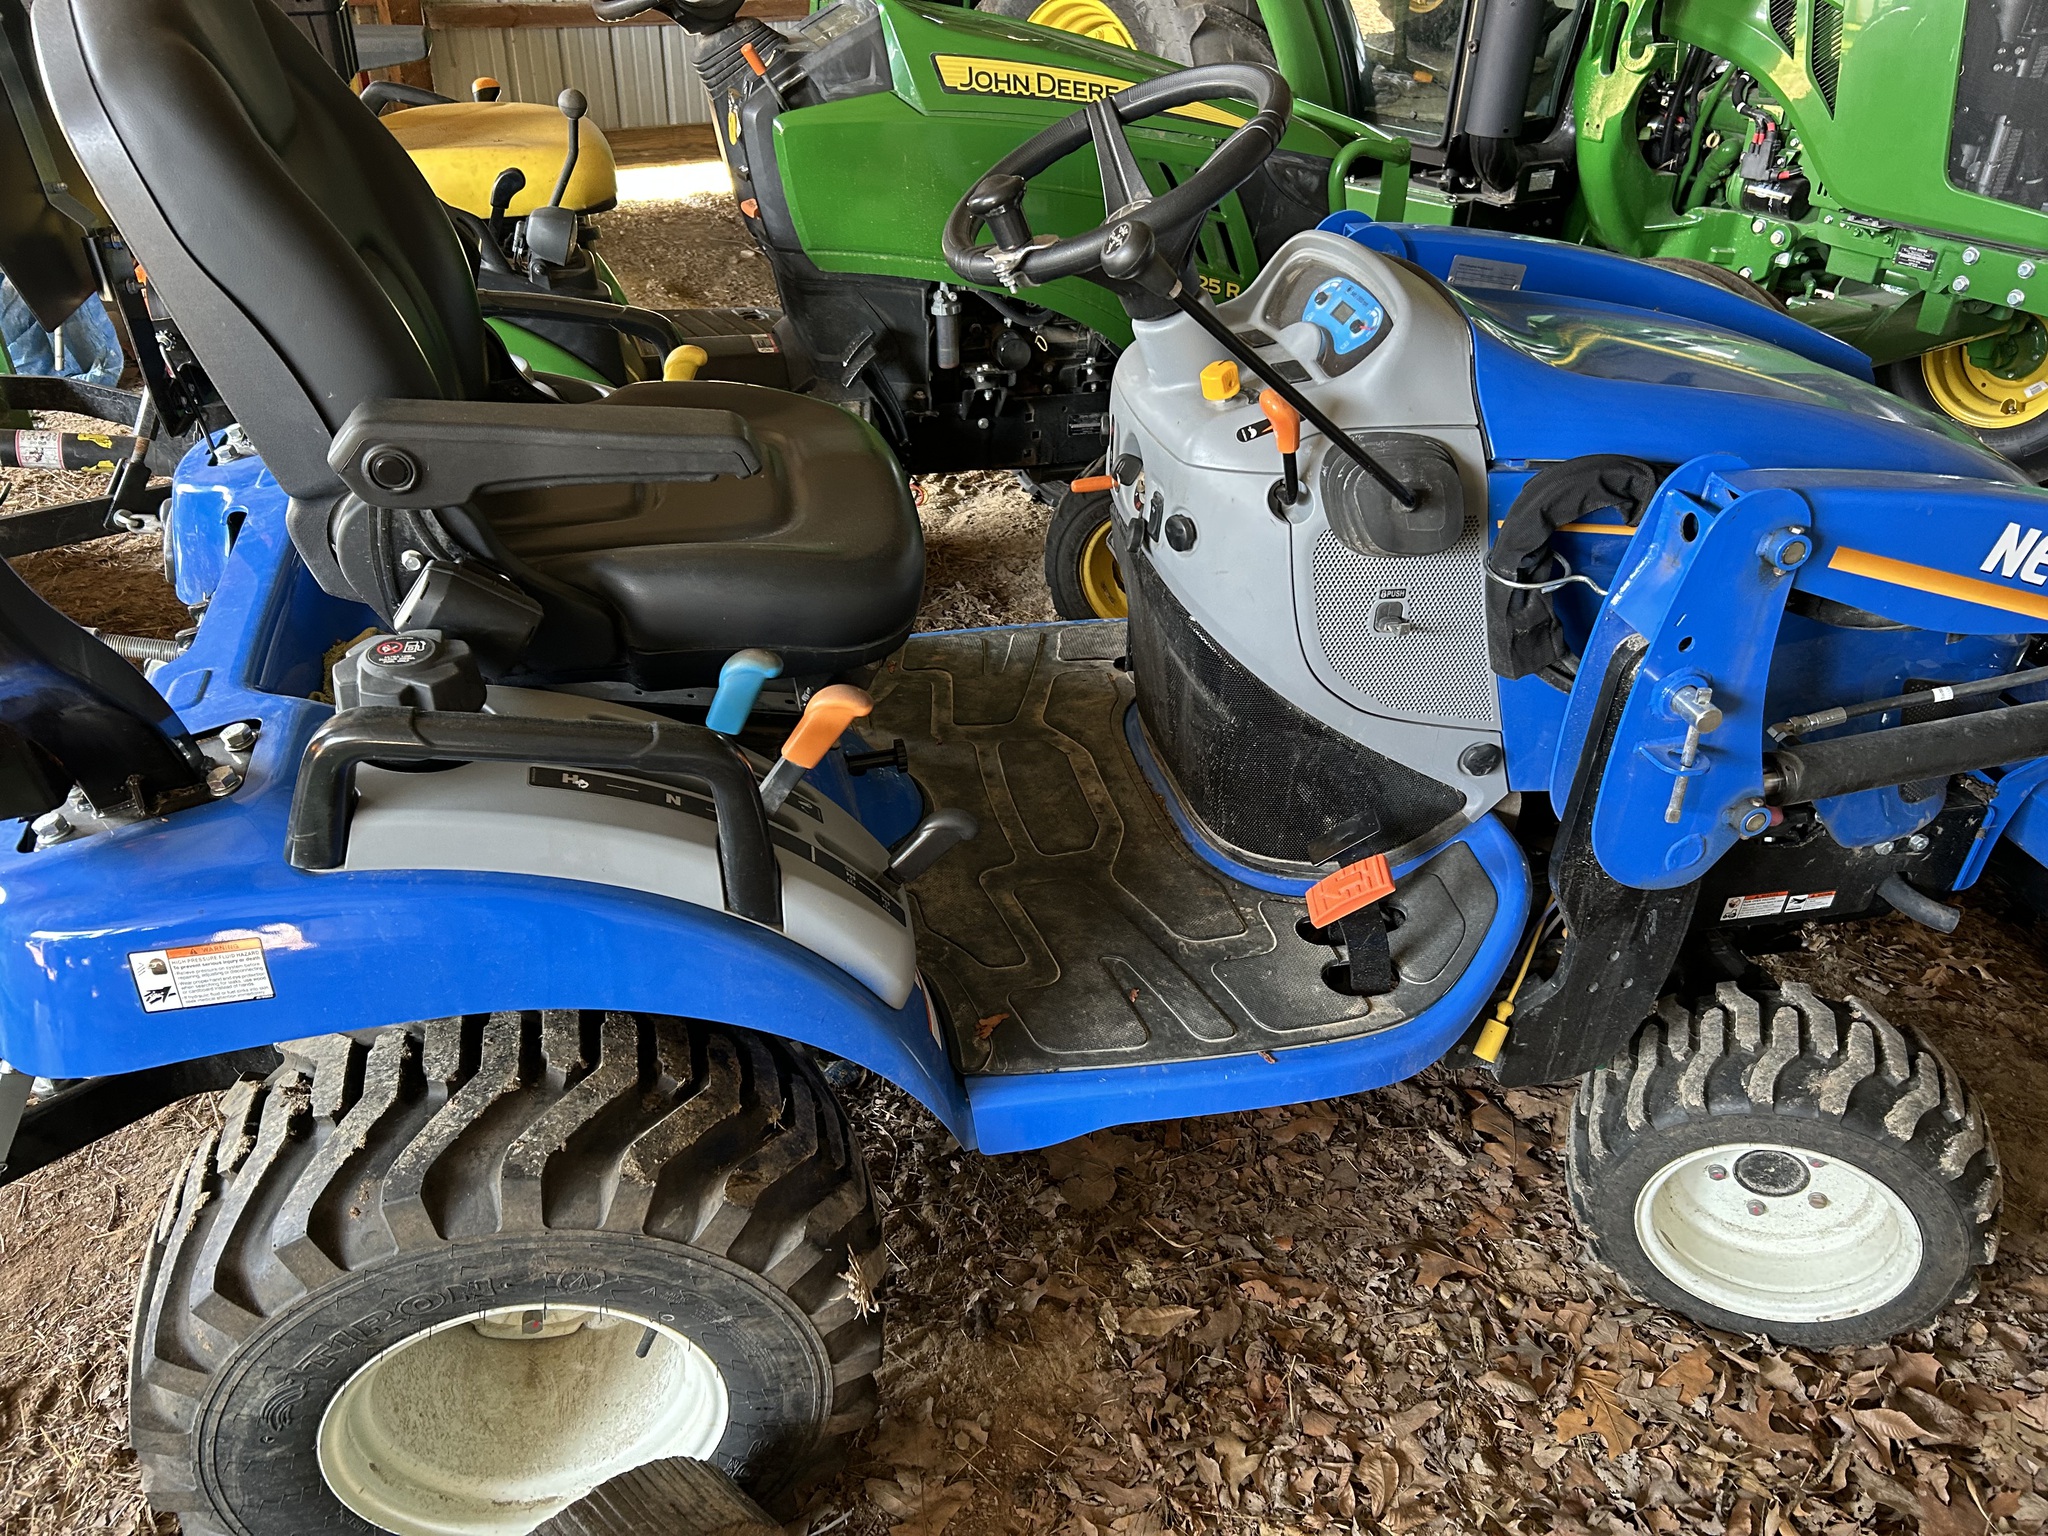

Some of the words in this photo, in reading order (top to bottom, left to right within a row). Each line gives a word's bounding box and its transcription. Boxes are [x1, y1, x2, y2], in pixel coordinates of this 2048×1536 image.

[960, 66, 1030, 93] JOHN
[1386, 590, 1406, 598] PUSH
[665, 793, 682, 806] N
[201, 943, 239, 953] WARNING
